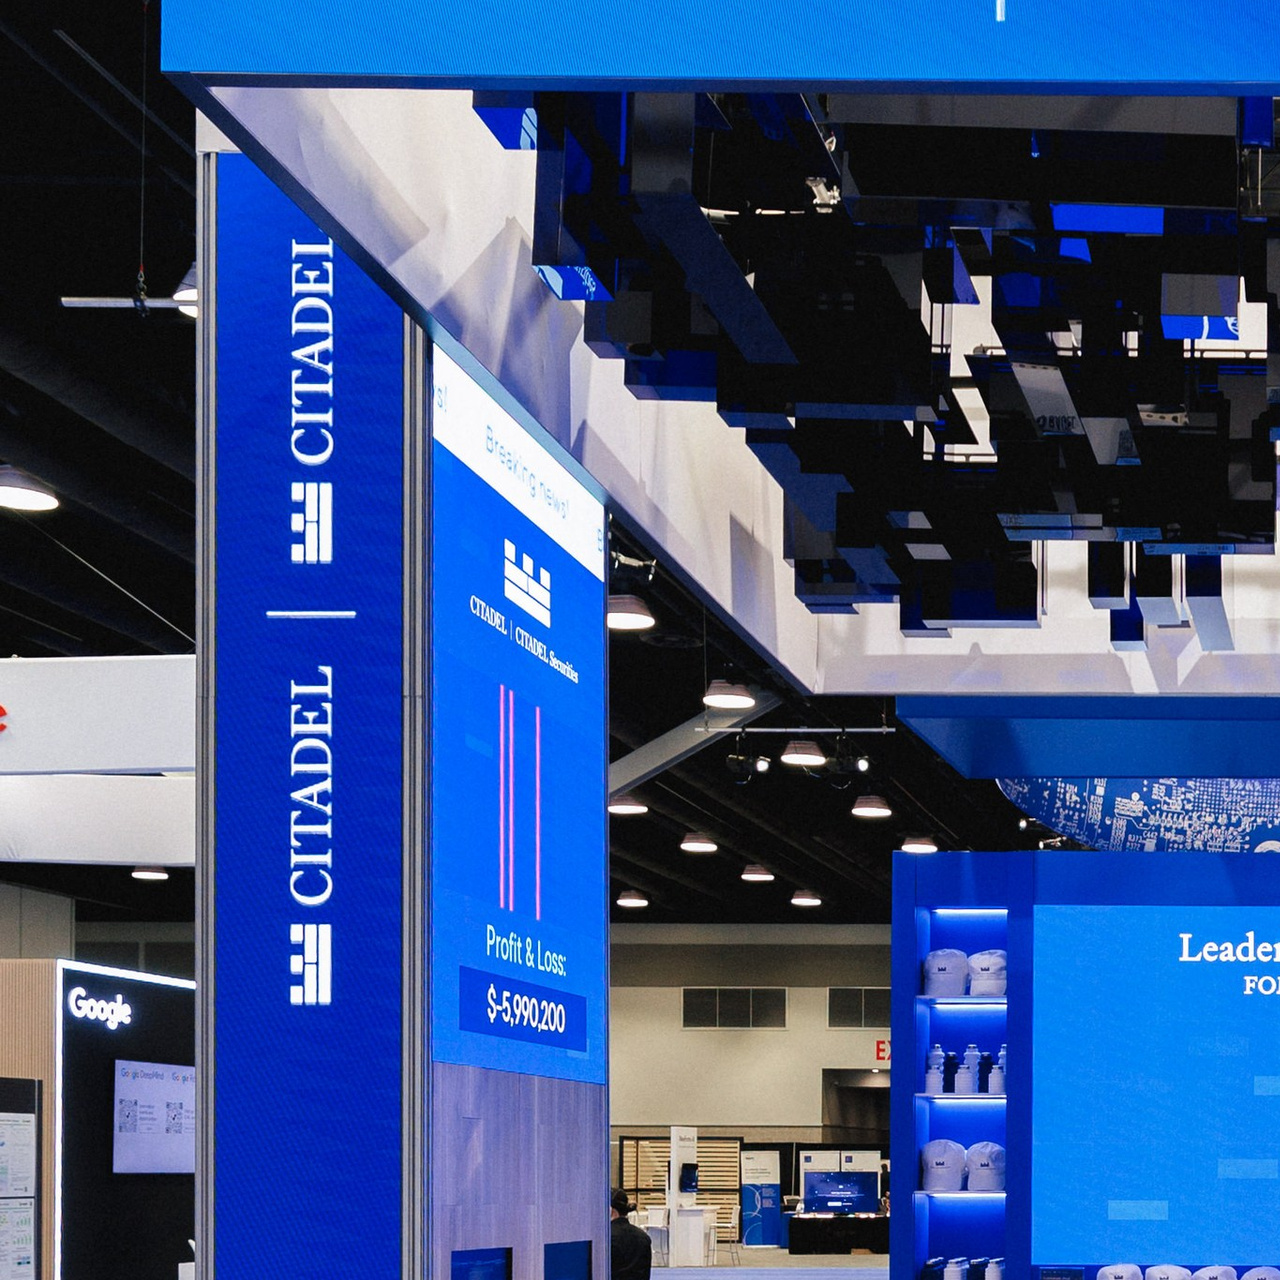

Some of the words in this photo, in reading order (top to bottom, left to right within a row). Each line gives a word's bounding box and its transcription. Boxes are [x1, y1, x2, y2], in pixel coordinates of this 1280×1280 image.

[486, 424, 537, 498] Breaking
[469, 594, 508, 636] CITADEL
[515, 626, 549, 665] CITADEL
[549, 650, 579, 685] Securities
[289, 665, 333, 907] CITADEL
[486, 923, 523, 966] Profit
[525, 936, 535, 969] &
[537, 939, 567, 977] Loss:
[68, 986, 132, 1030] Google
[487, 983, 566, 1034] $-5,990,200
